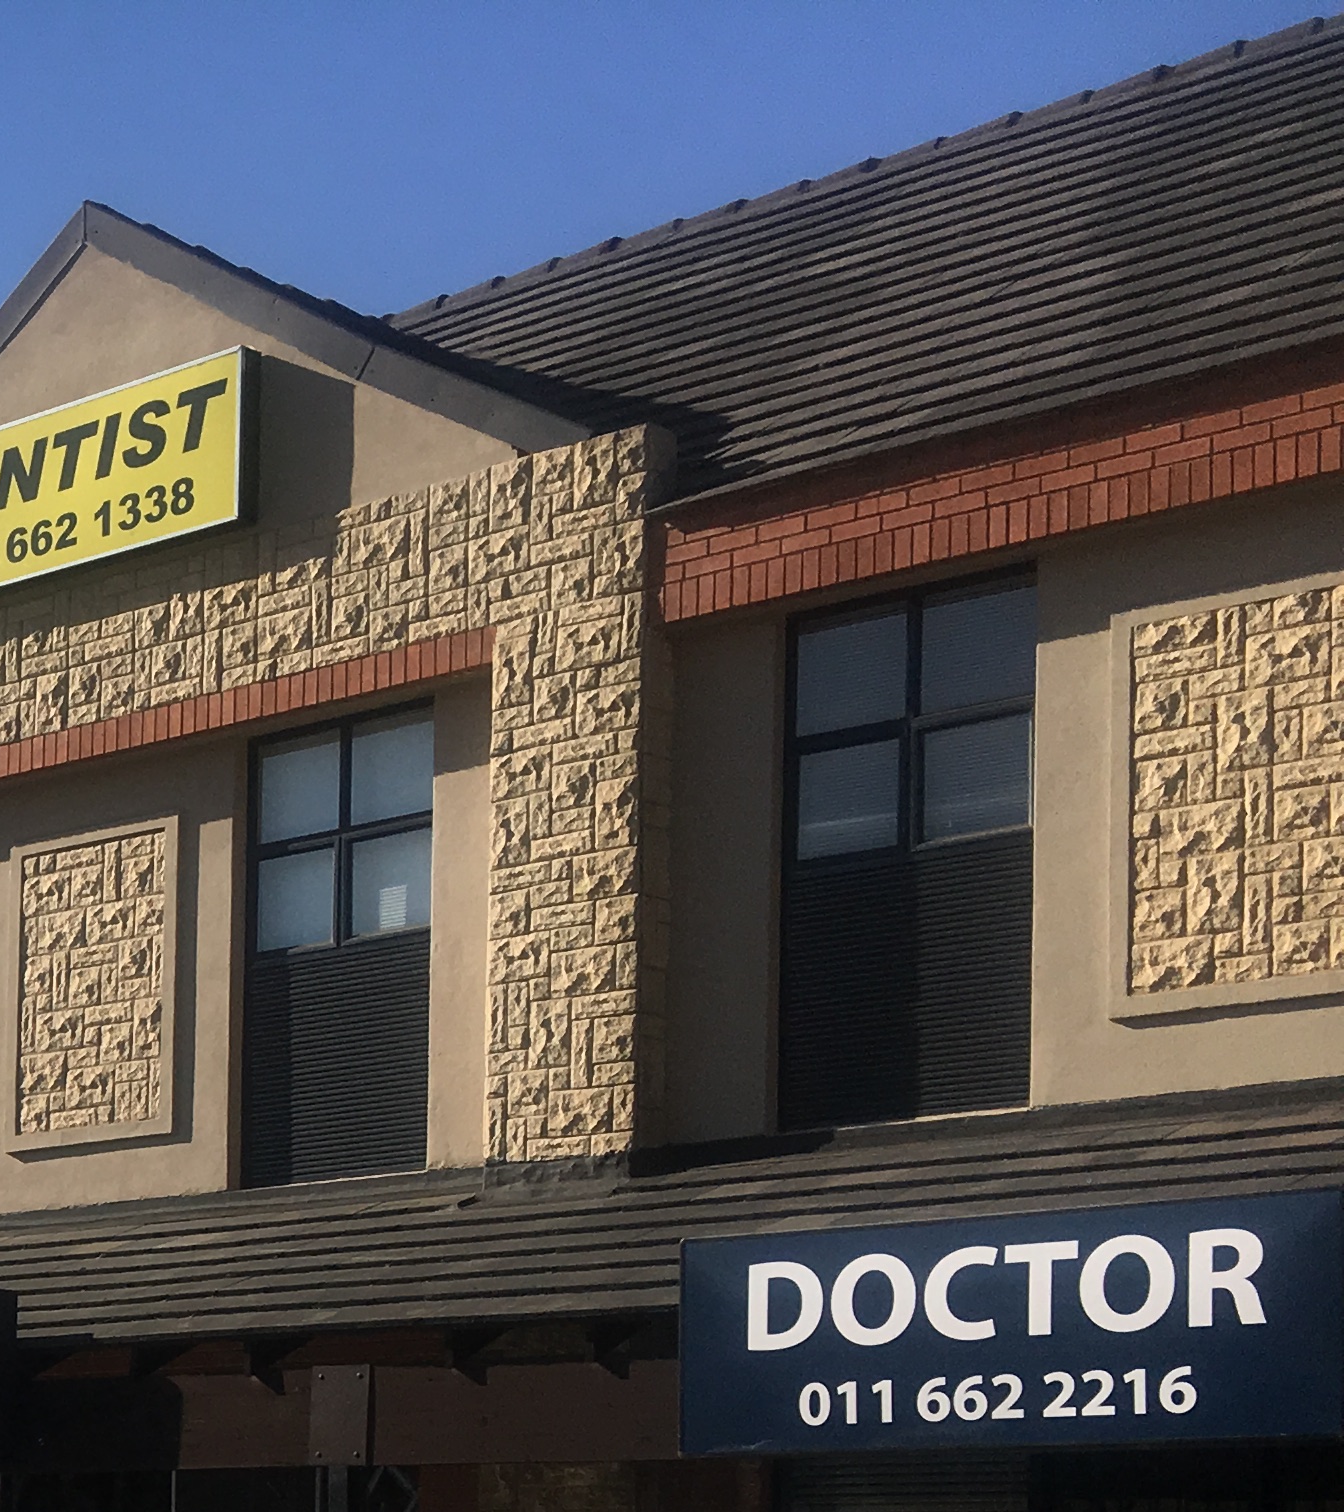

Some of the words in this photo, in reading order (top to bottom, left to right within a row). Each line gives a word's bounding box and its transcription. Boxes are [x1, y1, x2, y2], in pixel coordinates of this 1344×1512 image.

[6, 513, 78, 563] 662
[94, 476, 195, 538] 1338
[747, 1229, 1267, 1352] DOCTOR
[799, 1380, 895, 1426] 011
[916, 1373, 1025, 1423] 662
[1043, 1365, 1197, 1417] 2216
